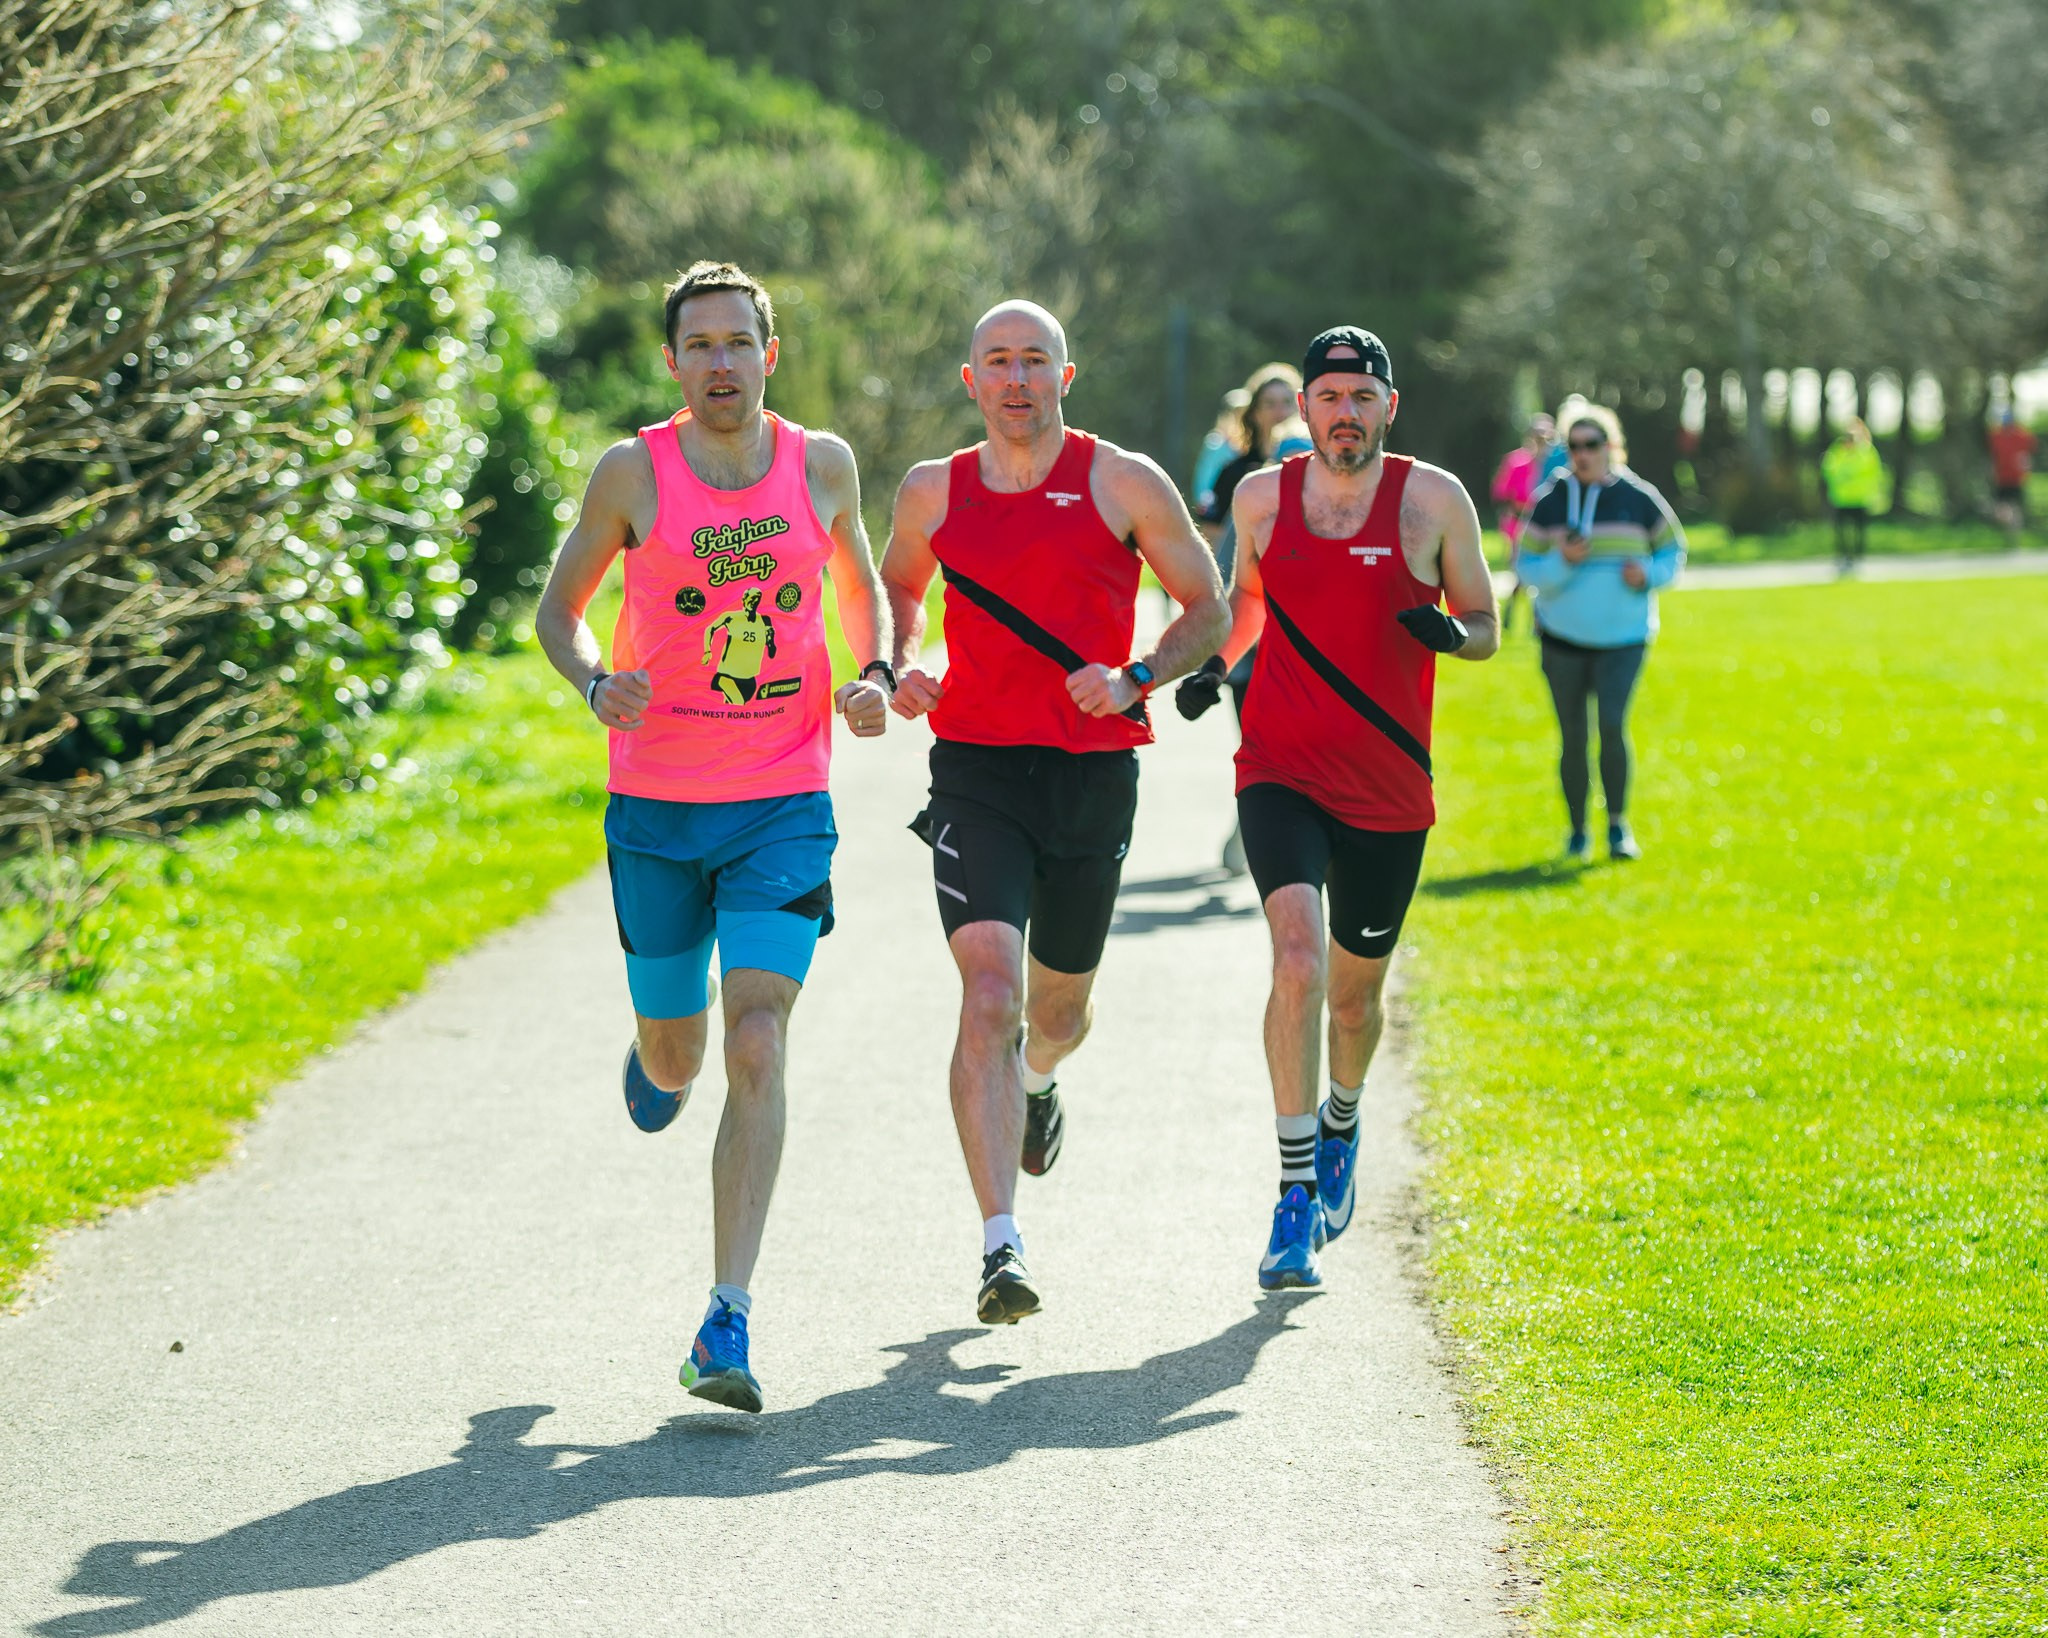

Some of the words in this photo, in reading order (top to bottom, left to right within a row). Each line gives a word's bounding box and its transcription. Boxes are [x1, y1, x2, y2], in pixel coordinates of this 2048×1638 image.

[692, 515, 790, 558] Feighan
[1363, 555, 1377, 565] AC
[708, 553, 777, 586] Fury
[743, 631, 756, 643] 25
[672, 706, 700, 716] SOUTH
[701, 709, 725, 719] WEST
[727, 711, 752, 719] ROAD
